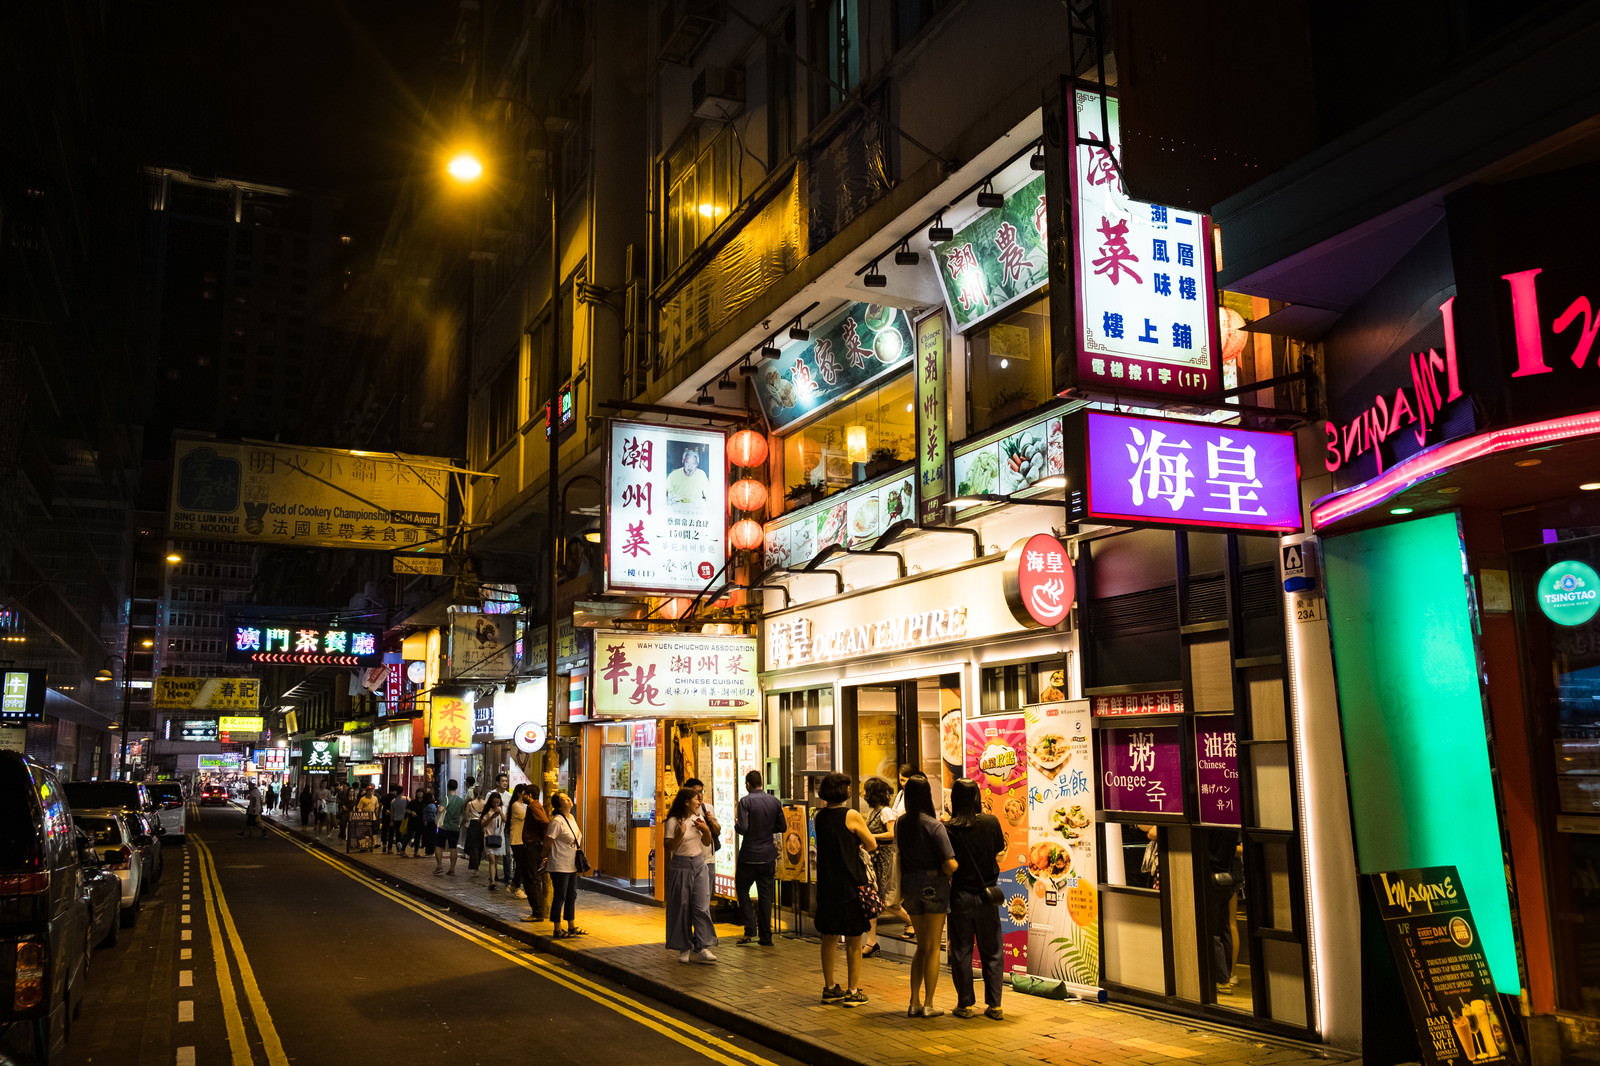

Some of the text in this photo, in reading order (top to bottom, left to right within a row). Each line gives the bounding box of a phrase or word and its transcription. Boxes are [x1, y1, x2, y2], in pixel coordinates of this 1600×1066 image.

[1175, 216, 1197, 301] 一層樓
[920, 329, 941, 343] Chinese
[1103, 311, 1193, 350] 樓上鋪
[924, 337, 937, 350] Food
[923, 351, 941, 463] 潮州菜
[1125, 426, 1268, 517] 海皇
[622, 436, 653, 558] 潮州菜
[174, 512, 240, 525] SING LUM KHUI
[269, 503, 287, 515] God
[288, 504, 296, 515] of
[297, 505, 331, 519] Cookery
[333, 507, 390, 523] Championship
[414, 513, 438, 525] Award
[174, 522, 240, 534] RICE NOODLE
[1026, 550, 1065, 574] 海皇
[1544, 590, 1597, 604] TSINGTAO
[1297, 609, 1315, 620] 23A
[235, 626, 376, 656] 澳門茶餐廳
[812, 605, 969, 658] OCEAN EMPIRE
[637, 642, 653, 650] WAH
[674, 643, 710, 651] CHIUCHOW
[600, 641, 666, 707] 華苑
[670, 654, 750, 675] 潮州菜
[222, 681, 255, 698] 春記
[712, 678, 745, 686] CUISINE
[1096, 692, 1184, 715] 新鮮即炸油器
[438, 699, 468, 746] 米線
[1128, 732, 1156, 773] 粥
[1204, 732, 1237, 758] 油器
[1199, 760, 1226, 769] Chinese
[1105, 771, 1147, 792] Congee
[1201, 783, 1231, 795] 揚げパン
[1145, 780, 1167, 811] 죽
[1216, 799, 1234, 812] 유기
[1417, 930, 1433, 939] EVERY
[1433, 926, 1448, 937] DAY
[1426, 1015, 1448, 1027] BAR
[1430, 1030, 1452, 1041] YOUR
